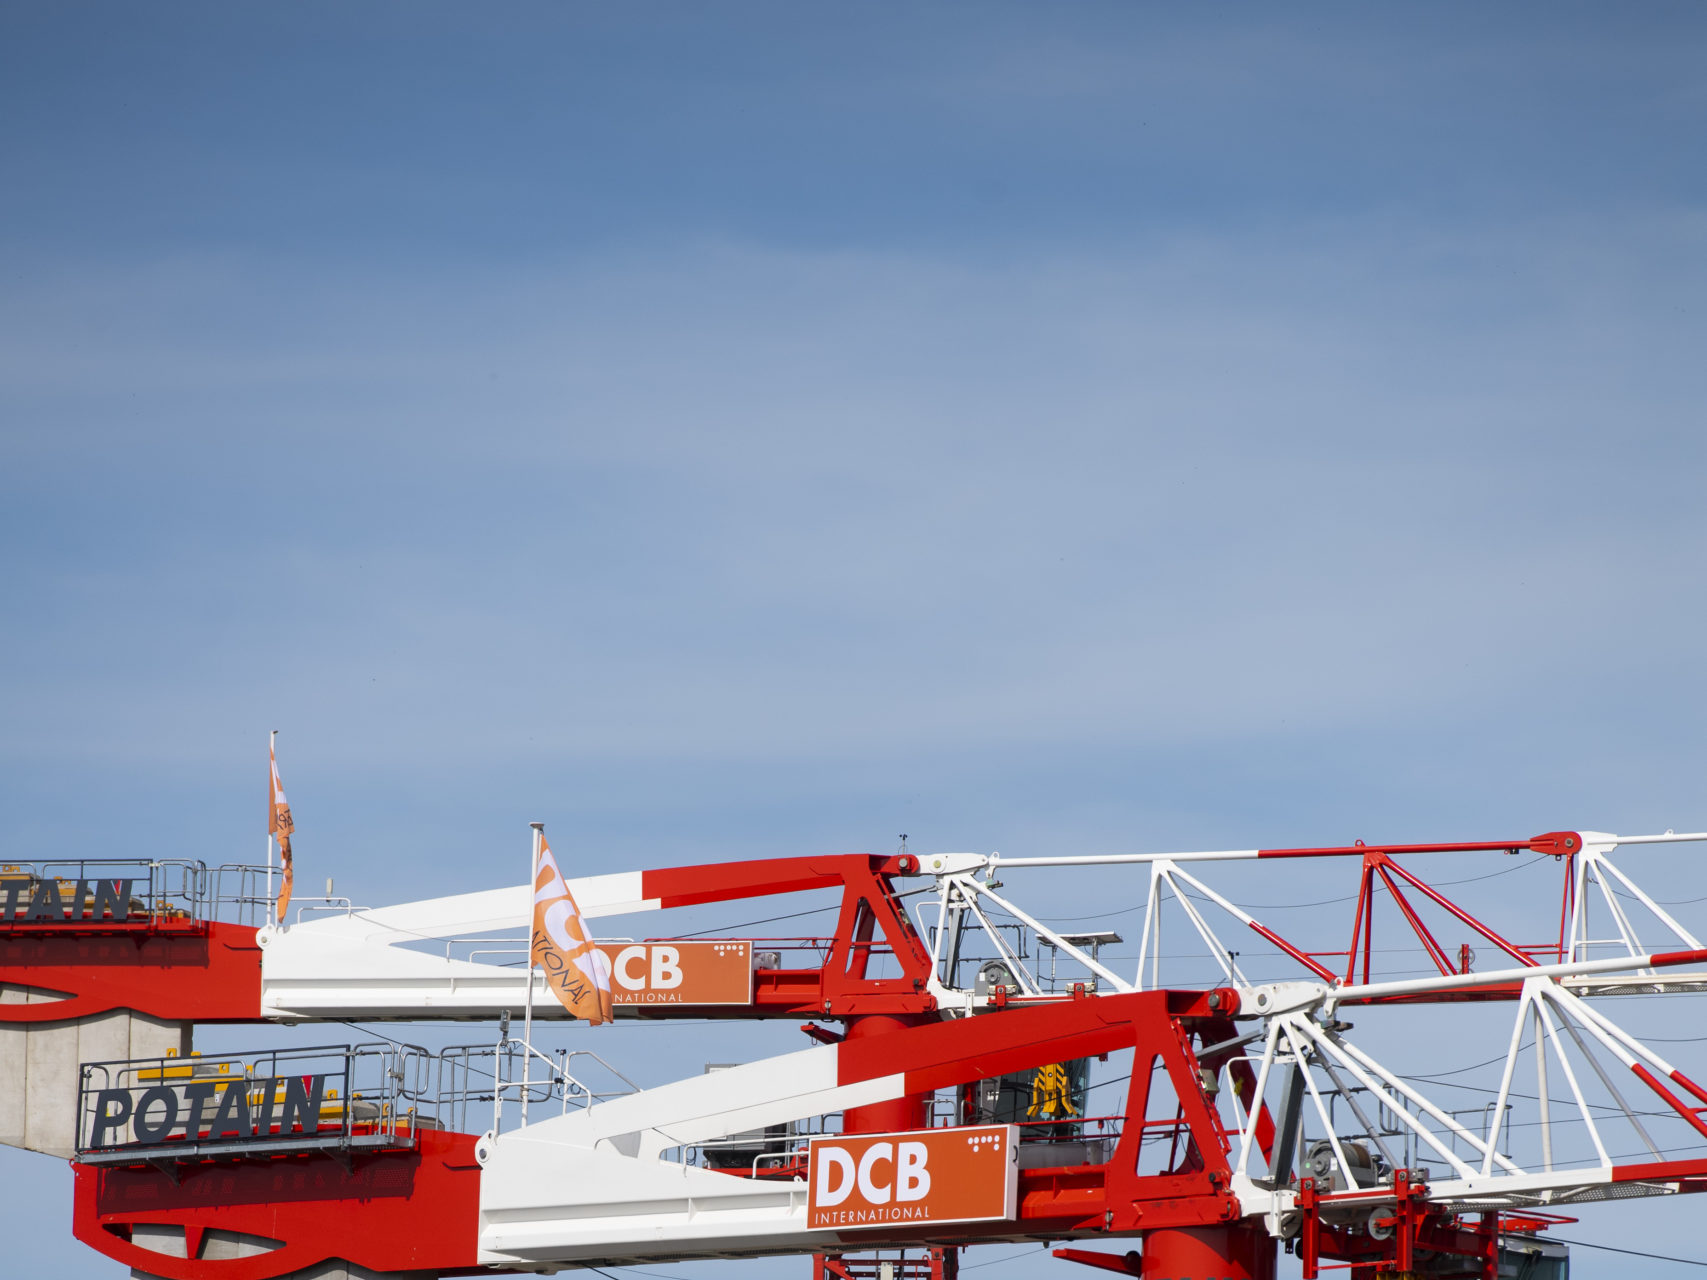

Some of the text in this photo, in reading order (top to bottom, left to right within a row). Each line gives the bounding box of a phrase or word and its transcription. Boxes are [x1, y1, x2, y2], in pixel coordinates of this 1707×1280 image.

[90, 1075, 325, 1147] POTAIN
[816, 1142, 931, 1207] DCB
[815, 1206, 929, 1224] INTERNATIONAL
